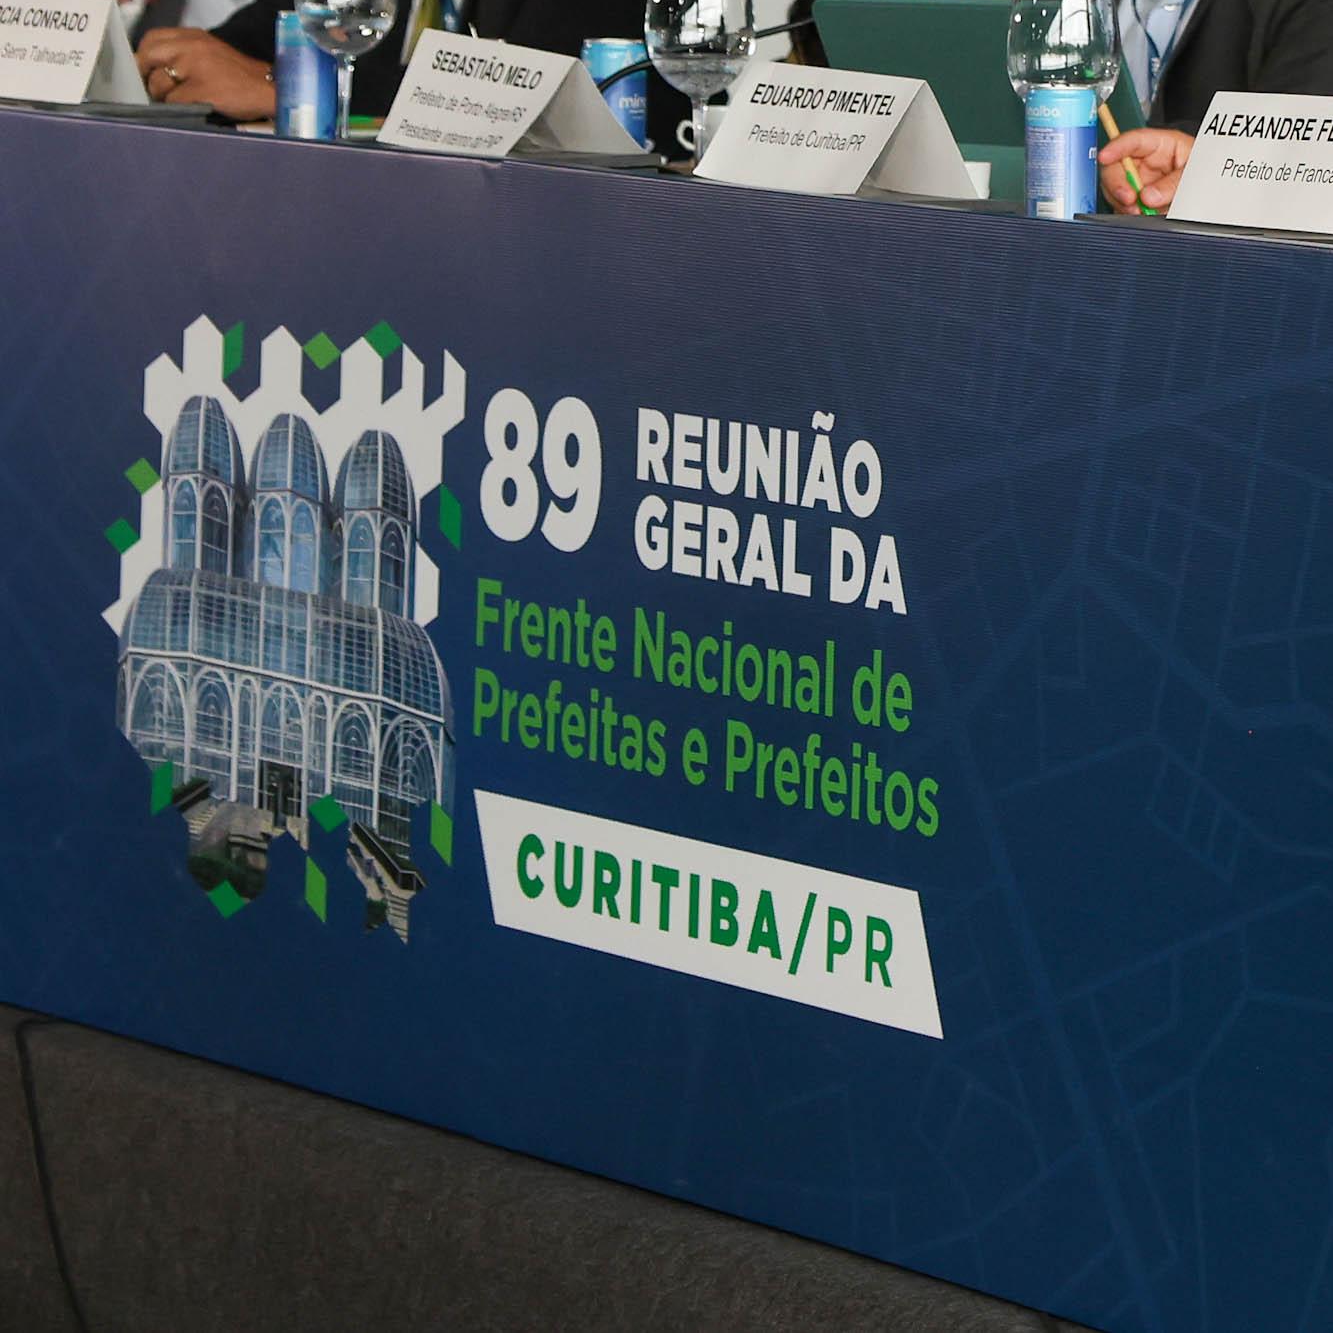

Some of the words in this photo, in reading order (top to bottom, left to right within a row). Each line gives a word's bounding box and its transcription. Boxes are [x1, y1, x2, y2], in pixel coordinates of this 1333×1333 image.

[0, 4, 21, 25] CIA
[23, 7, 89, 33] CONRADO
[431, 49, 501, 82] SEBASTIÃO
[502, 66, 543, 90] MELO
[750, 83, 825, 110] EDUARDO
[825, 91, 896, 116] PIMENTEL
[748, 124, 789, 147] Prefeito
[790, 127, 805, 148] de
[1204, 113, 1317, 141] ALEXANDRE
[1221, 157, 1274, 181] Prefeito
[1275, 161, 1292, 182] de
[480, 388, 600, 552] 89
[636, 407, 883, 519] REUNIÃO
[634, 495, 812, 600] GERAL
[831, 524, 908, 615] DA
[476, 578, 615, 672] Frente
[635, 604, 834, 718] Nacional
[851, 646, 912, 733] de
[473, 667, 667, 779] Prefeitas
[682, 729, 708, 786] e
[727, 720, 939, 838] Prefeitos
[518, 832, 893, 988] CURITIBA/PR
